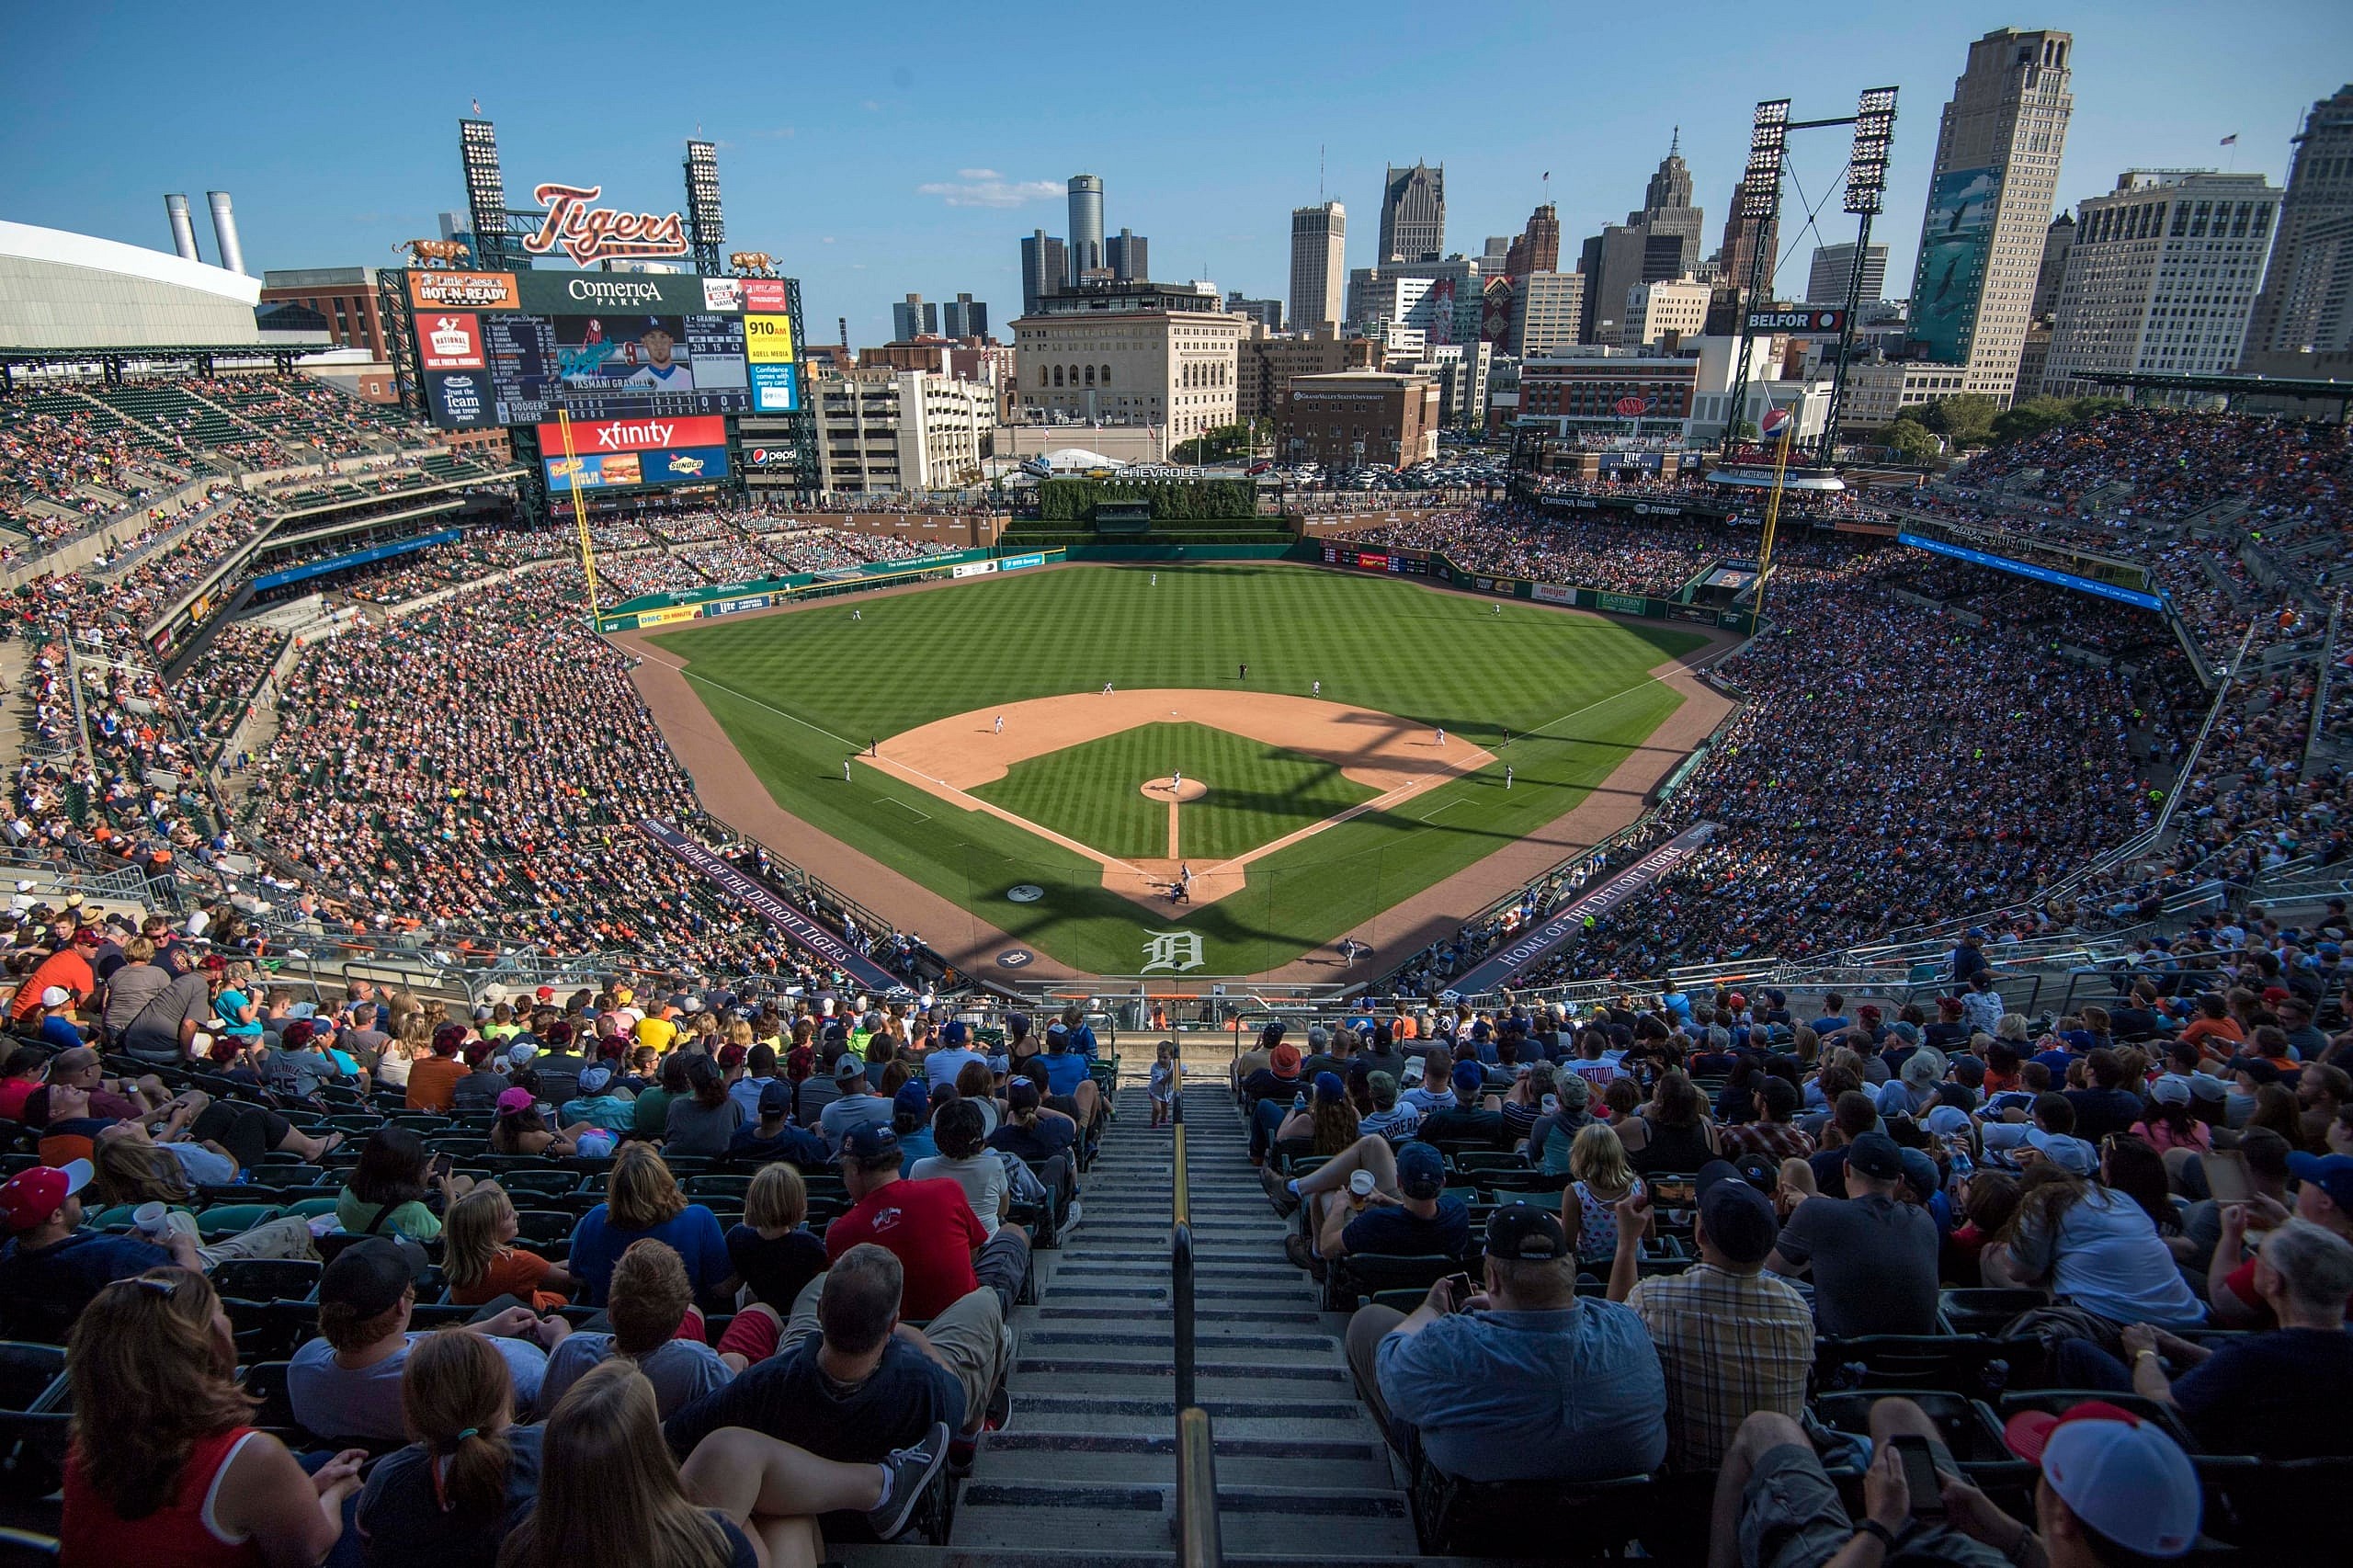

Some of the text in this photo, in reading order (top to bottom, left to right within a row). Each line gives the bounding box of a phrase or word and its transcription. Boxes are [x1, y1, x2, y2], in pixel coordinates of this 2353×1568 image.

[523, 183, 688, 268] Tigers
[437, 275, 503, 288] Little Caesars
[712, 283, 733, 291] HOUSE
[420, 287, 508, 301] HOT-N-READY
[569, 279, 663, 301] Comerica
[712, 291, 730, 300] SOLD
[597, 298, 640, 306] PARK
[1749, 314, 1809, 327] BELFOR
[749, 322, 774, 335] 910
[691, 344, 740, 352] .263 15 43
[623, 341, 638, 367] 9
[573, 378, 651, 389] YASMANI GRANDAL
[444, 395, 480, 407] Team
[511, 402, 549, 411] DODGERS
[701, 397, 709, 406] 0
[721, 396, 728, 405] 0
[1618, 400, 1642, 414] AAA
[513, 412, 542, 422] TIGERS
[597, 420, 674, 449] xfinity
[769, 449, 796, 462] pepsi
[1623, 452, 1641, 462] Lite
[671, 460, 702, 470] SUNOCO
[1120, 467, 1208, 478] CHEVROLET
[1739, 470, 1774, 480] AMSTERDAM
[1541, 496, 1597, 508] Comerica Bank
[1651, 506, 1681, 516] DETROIT
[1738, 516, 1761, 526] pepsi
[896, 559, 917, 568] University
[1024, 558, 1040, 566] Energy
[1540, 586, 1568, 597] meijer
[1603, 594, 1641, 606] EASTERN
[720, 602, 735, 614] Lite
[641, 614, 662, 624] DMC
[671, 610, 692, 619] MINUTE
[676, 842, 852, 961] HOME OF THE DETROIT TIGERS
[1497, 846, 1683, 966] HOME OF THE DETROIT TIGERS
